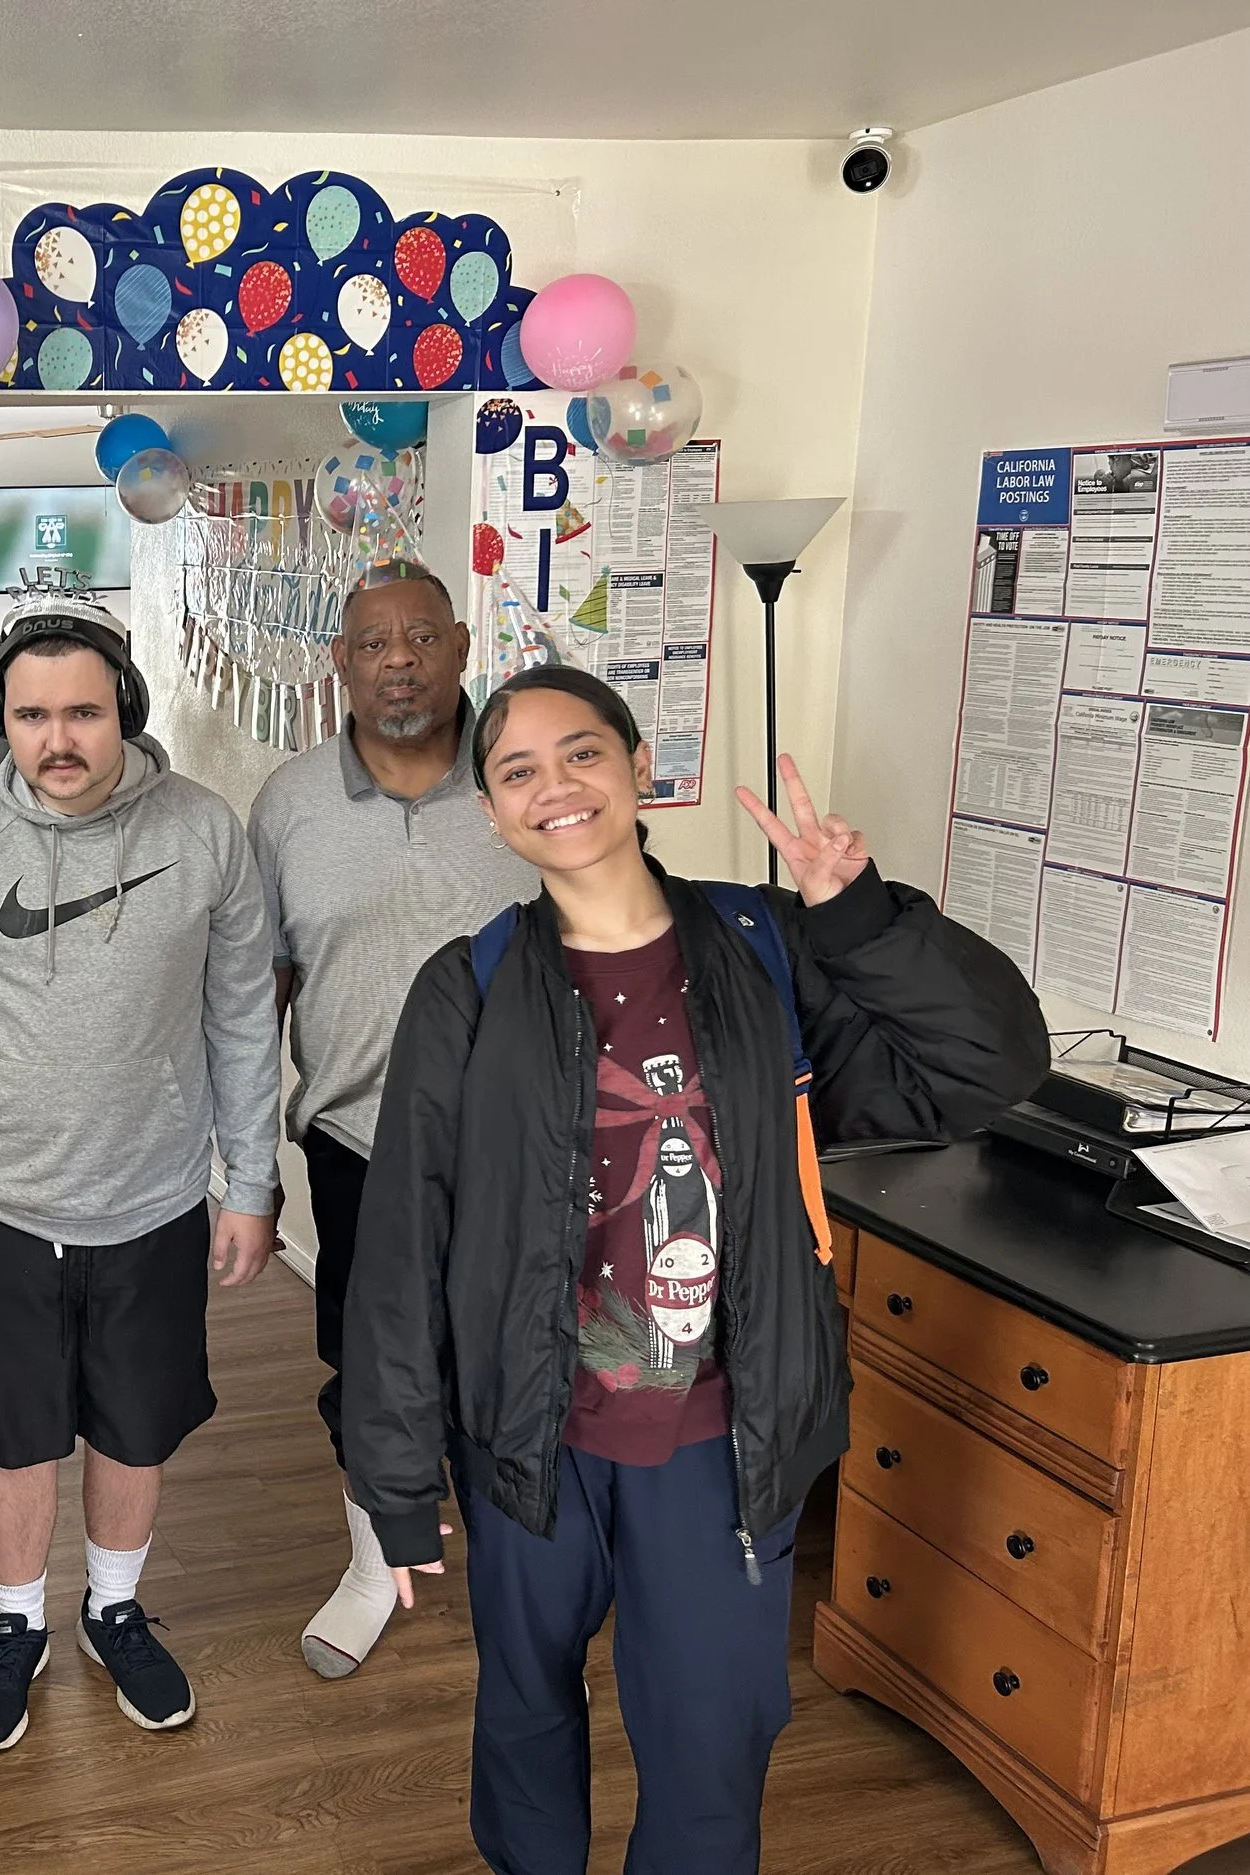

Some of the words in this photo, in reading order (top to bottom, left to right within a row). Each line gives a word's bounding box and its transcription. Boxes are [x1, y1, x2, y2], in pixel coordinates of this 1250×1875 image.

[997, 459, 1056, 473] CALIFORNIA
[996, 476, 1030, 488] LABOR
[1032, 475, 1055, 487] LAW
[999, 491, 1050, 503] POSTINGS
[669, 1153, 693, 1163] Pepper
[659, 1258, 674, 1269] 10
[701, 1254, 710, 1266] 2
[648, 1280, 664, 1298] Dr
[681, 1322, 693, 1334] 4
